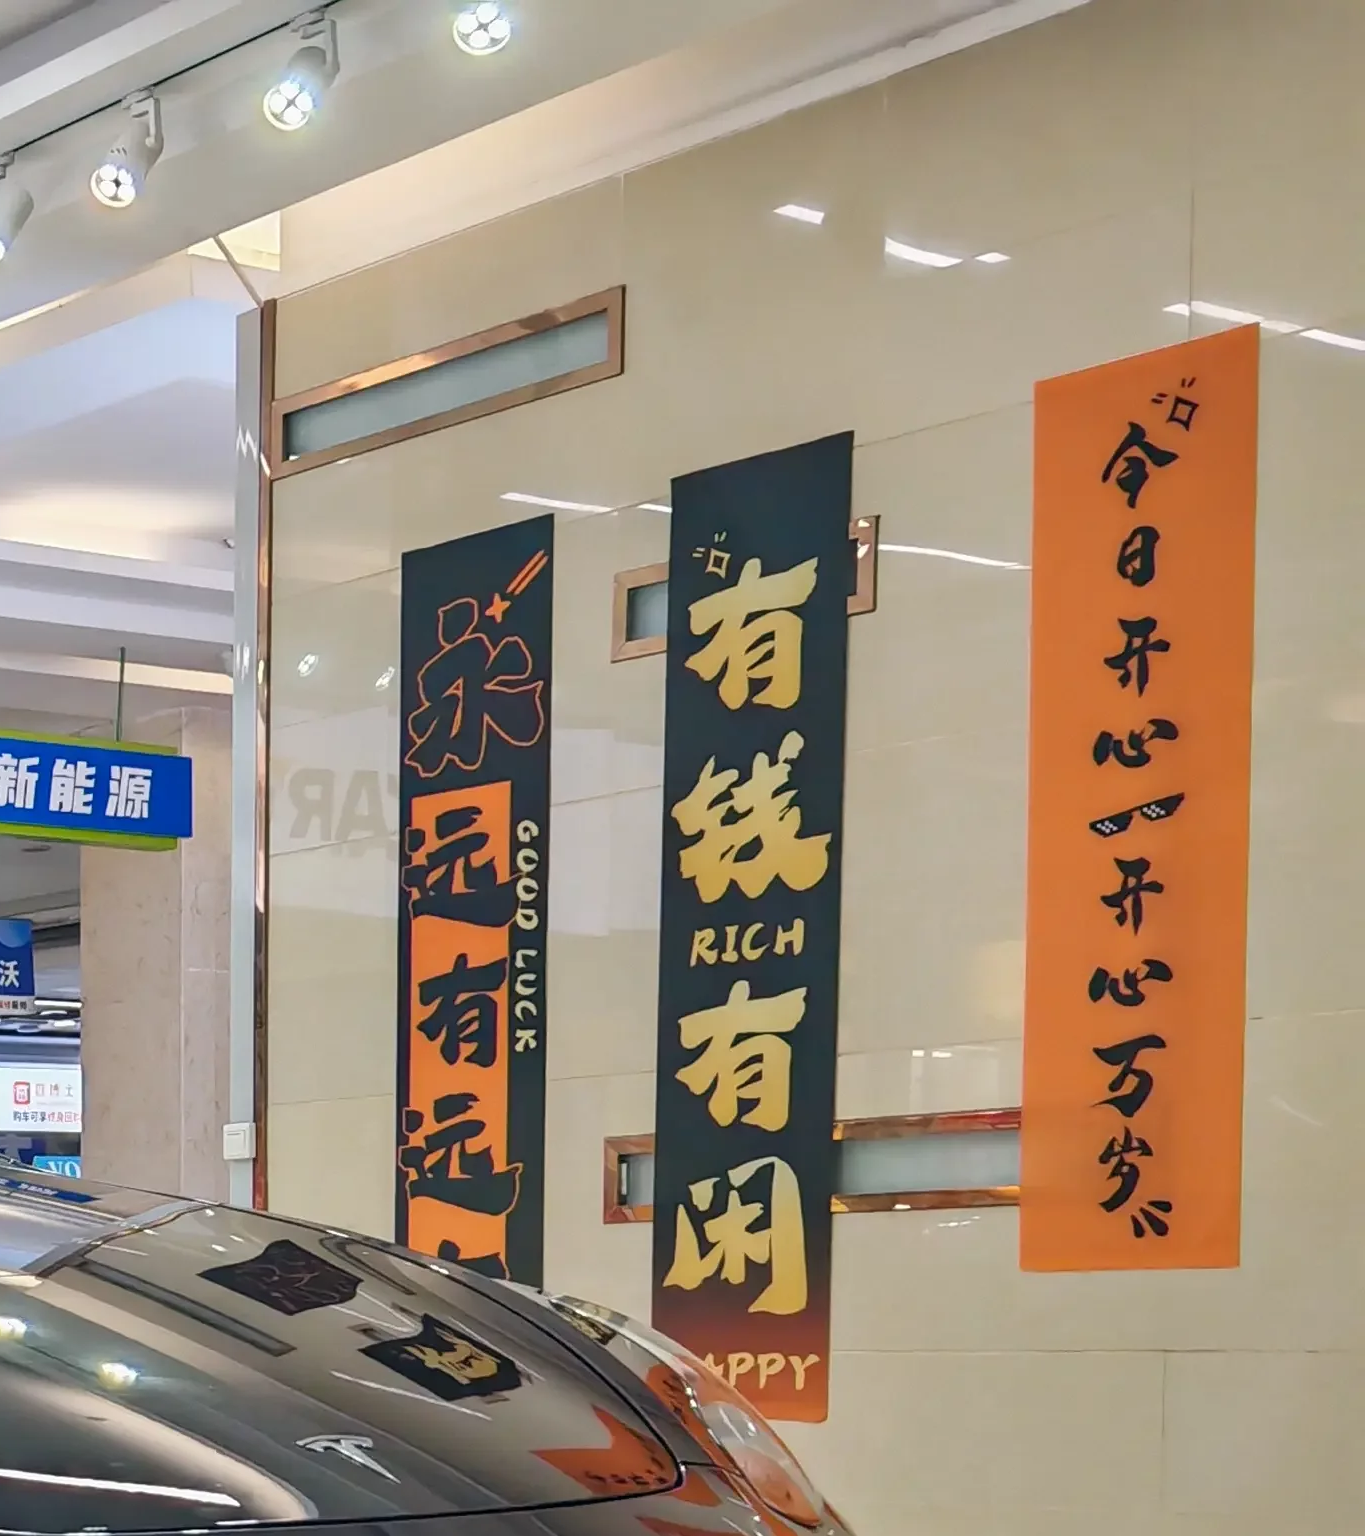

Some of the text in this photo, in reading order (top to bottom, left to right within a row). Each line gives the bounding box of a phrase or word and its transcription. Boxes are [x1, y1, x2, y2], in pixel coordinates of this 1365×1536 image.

[671, 556, 831, 903] 有钱
[399, 597, 544, 1282] 永远有远
[514, 820, 540, 1053] GOOD LUCK
[690, 918, 806, 968] RICH
[663, 980, 808, 1315] 有闲
